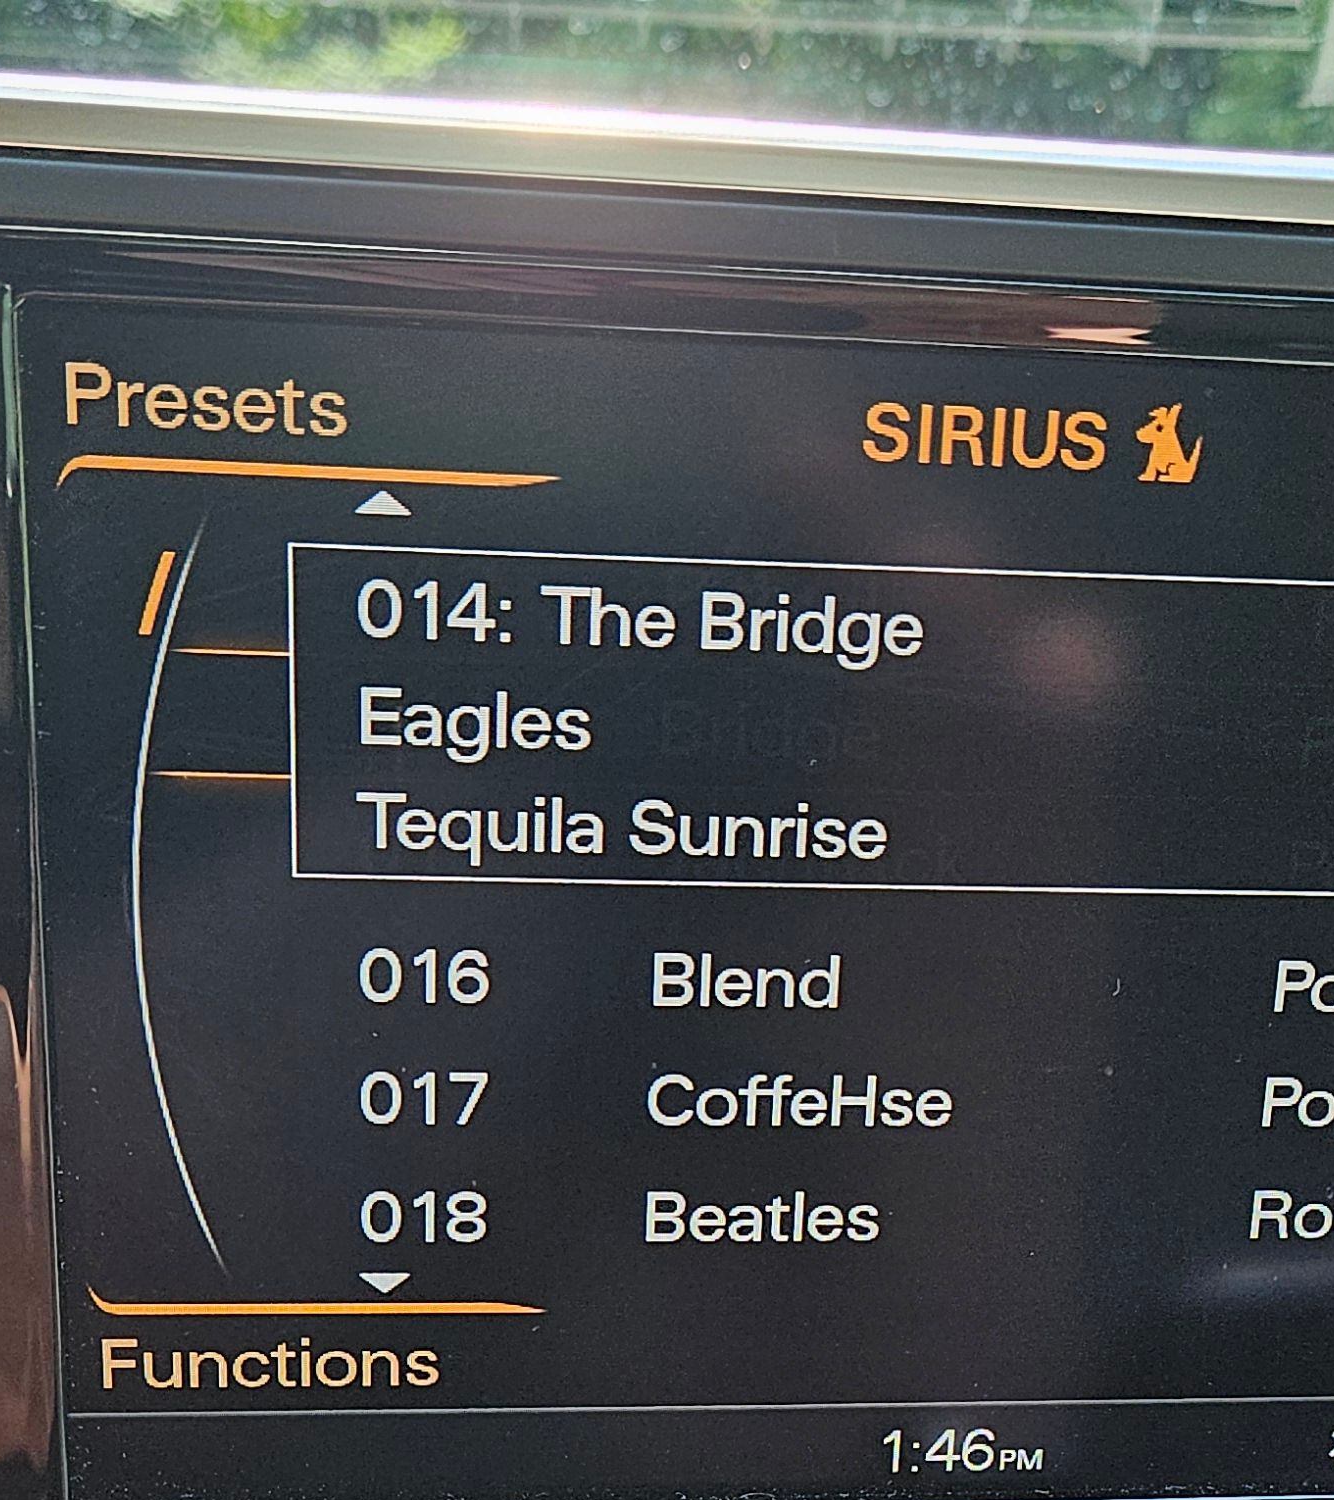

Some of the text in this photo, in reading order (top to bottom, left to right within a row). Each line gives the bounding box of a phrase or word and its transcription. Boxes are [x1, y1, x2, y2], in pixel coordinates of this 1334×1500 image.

[64, 361, 348, 437] Presets
[862, 401, 1108, 471] SIRIUS
[357, 578, 924, 671] 014: The Bridge
[360, 686, 591, 764] Eagles
[355, 791, 888, 867] Tequila Sunrise
[359, 947, 490, 1004] 016
[652, 952, 841, 1009] Blend
[360, 1071, 489, 1126] 017
[647, 1073, 953, 1127] CoffeHse
[360, 1190, 487, 1243] 018
[645, 1190, 880, 1242] Beatles
[101, 1337, 440, 1389] Functions
